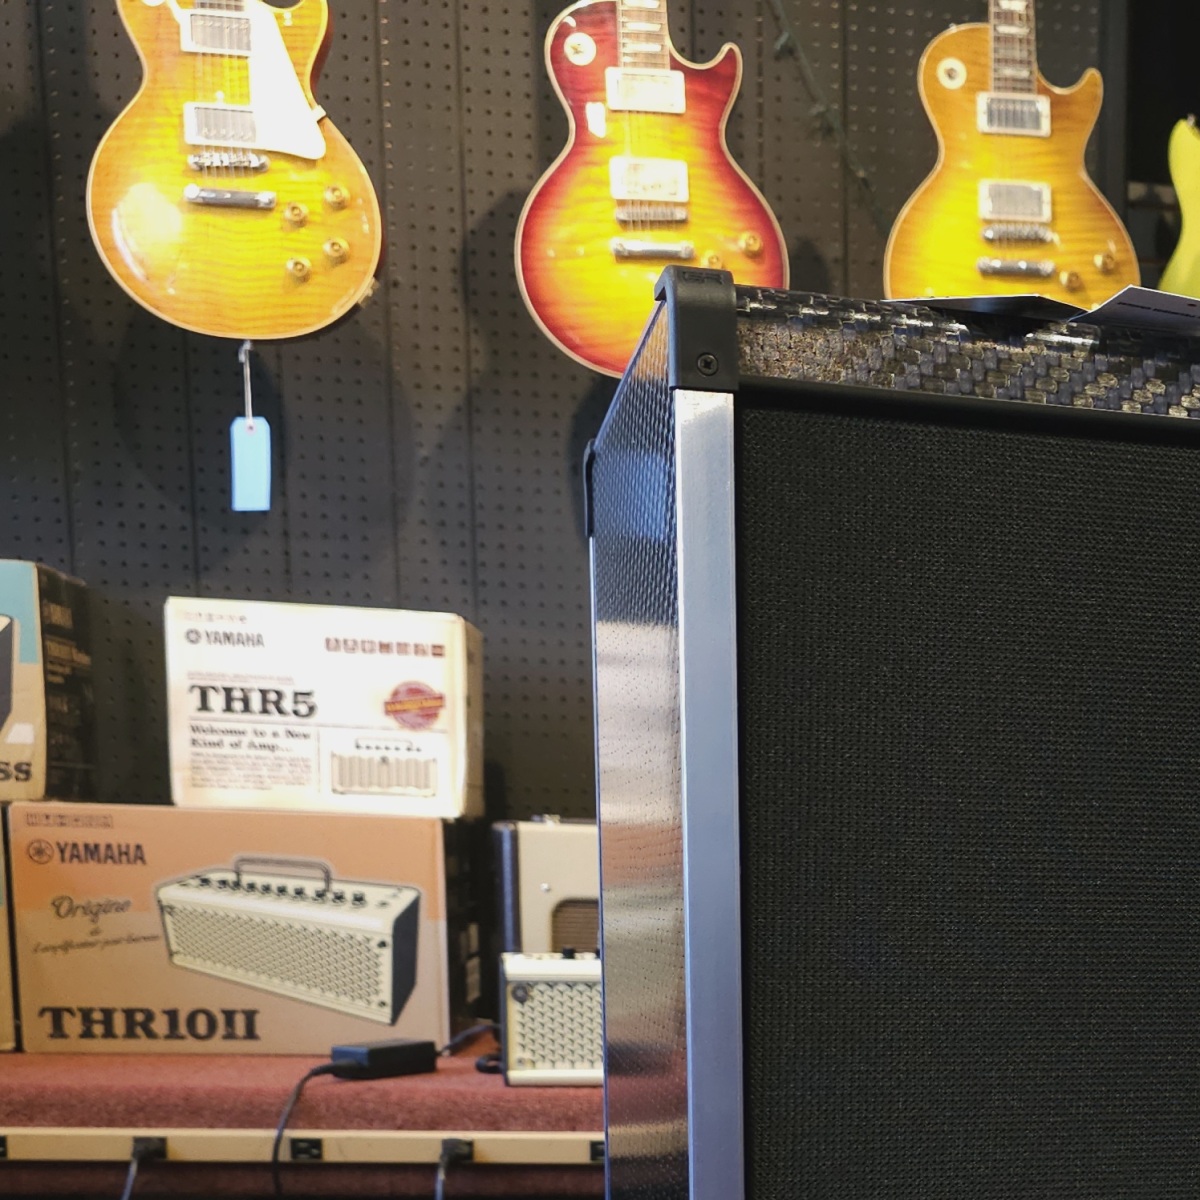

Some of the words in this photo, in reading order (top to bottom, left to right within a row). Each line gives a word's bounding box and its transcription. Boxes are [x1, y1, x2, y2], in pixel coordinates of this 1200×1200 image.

[204, 630, 265, 648] YAMAHA
[188, 684, 318, 717] THR5
[190, 724, 247, 736] Welcome
[253, 729, 267, 738] to
[271, 730, 279, 738] a
[286, 729, 311, 739] New
[191, 738, 224, 749] Kind
[229, 740, 243, 749] of
[56, 841, 147, 865] YAMAHA
[38, 1006, 261, 1040] THR10II
